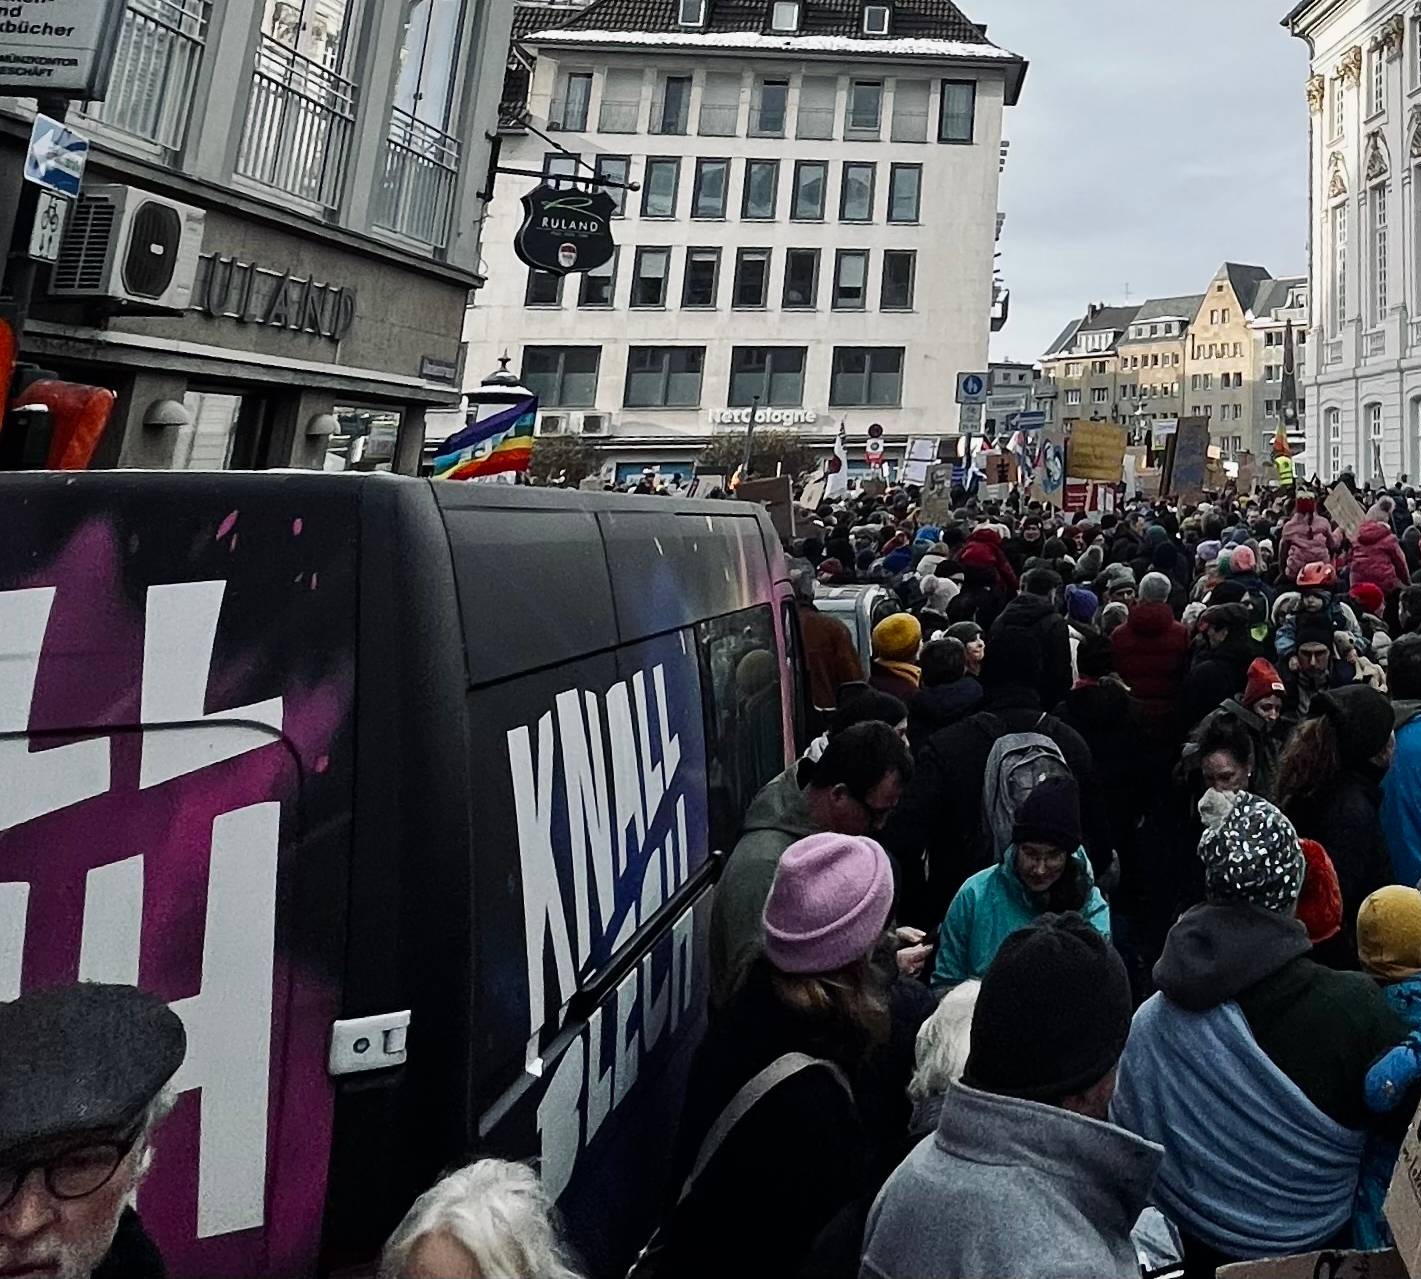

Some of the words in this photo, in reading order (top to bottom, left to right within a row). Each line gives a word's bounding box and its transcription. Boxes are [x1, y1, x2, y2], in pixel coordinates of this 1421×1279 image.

[541, 216, 599, 232] RULAND
[206, 252, 357, 340] ULAND
[708, 407, 817, 426] NetCologne
[507, 663, 680, 1065] KNALL
